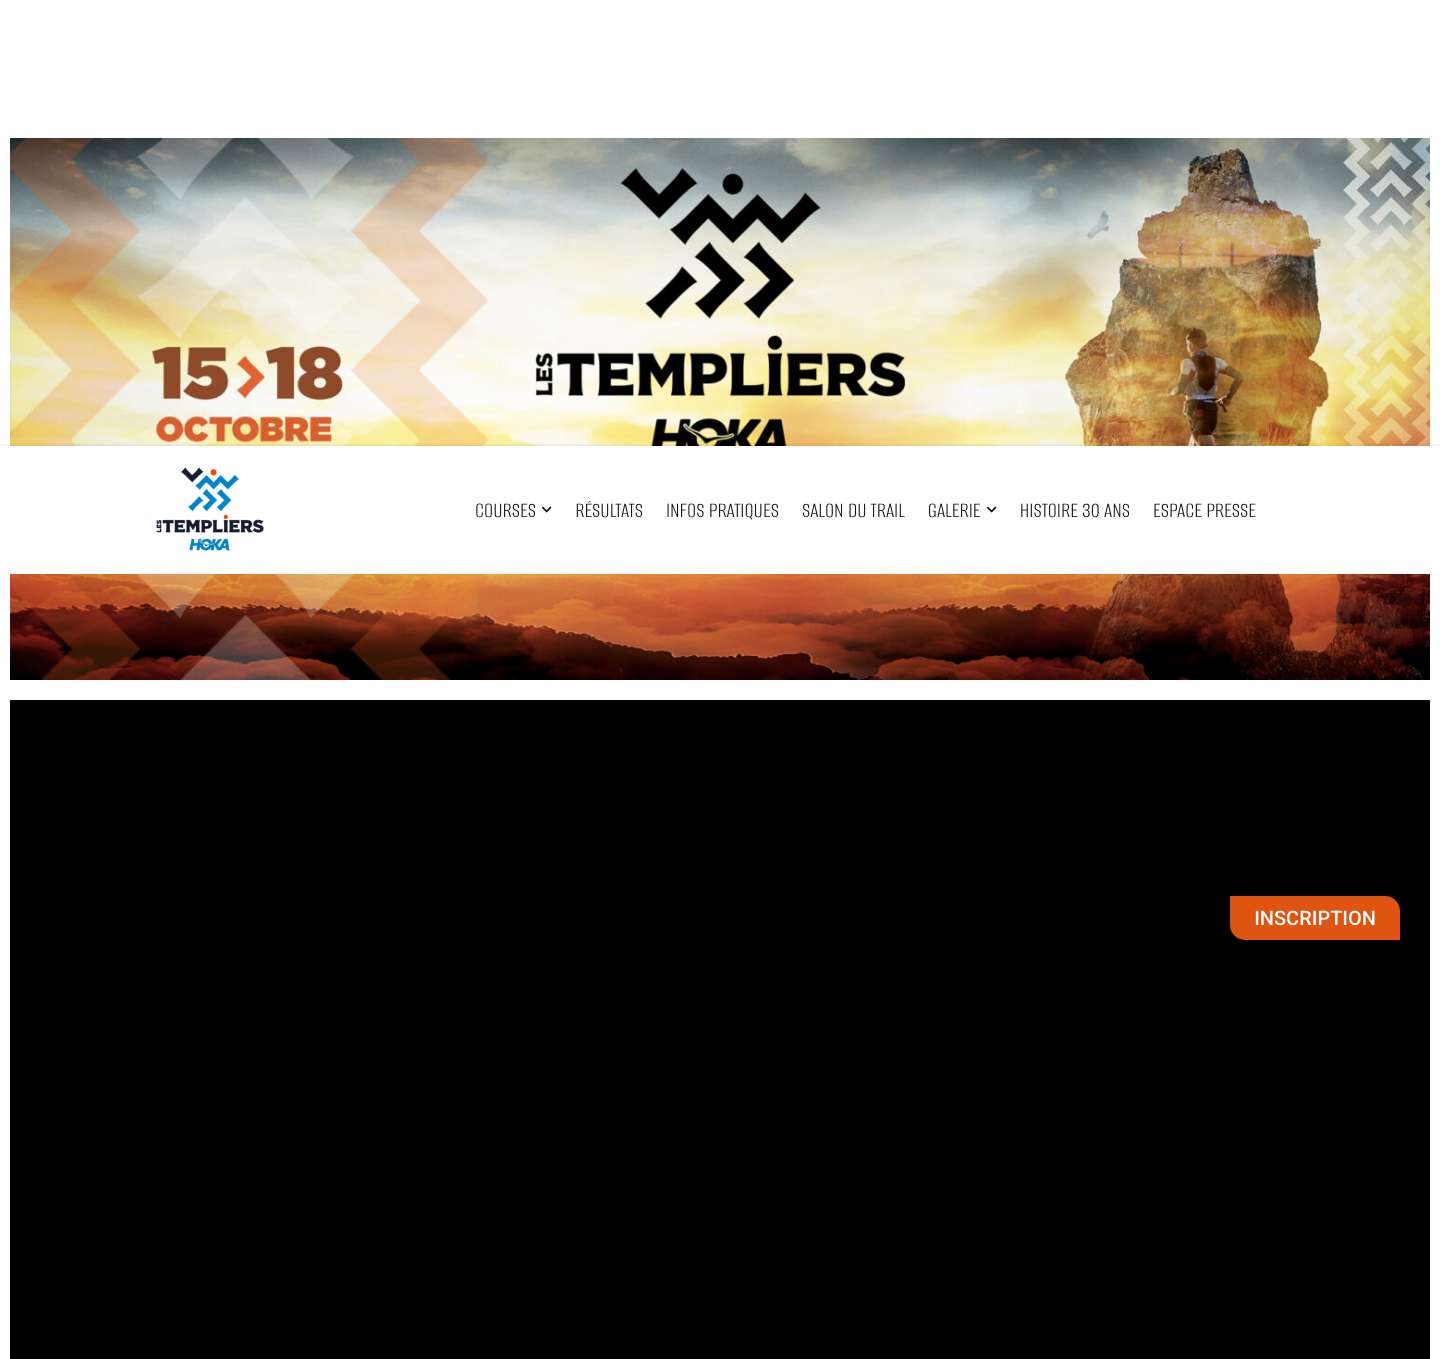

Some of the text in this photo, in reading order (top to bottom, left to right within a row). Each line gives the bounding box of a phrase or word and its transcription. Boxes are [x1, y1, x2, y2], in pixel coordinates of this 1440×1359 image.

[152, 346, 342, 401] 15 18
[535, 352, 553, 396] LES
[155, 415, 332, 443] OCTOBRE
[651, 418, 787, 446] HOKA
[475, 502, 536, 519] COURSES
[575, 500, 643, 519] RÉSULTATS
[666, 502, 779, 521] INFOS PRATIQUES
[802, 502, 906, 519] SALON DU TRAIL
[928, 502, 981, 518] GALERIE
[1020, 502, 1130, 518] HISTOIRE 30 ANS
[1153, 502, 1257, 518] ESPACE PRESSE
[189, 538, 230, 551] HOKA
[1255, 909, 1376, 927] INSCRIPTION
